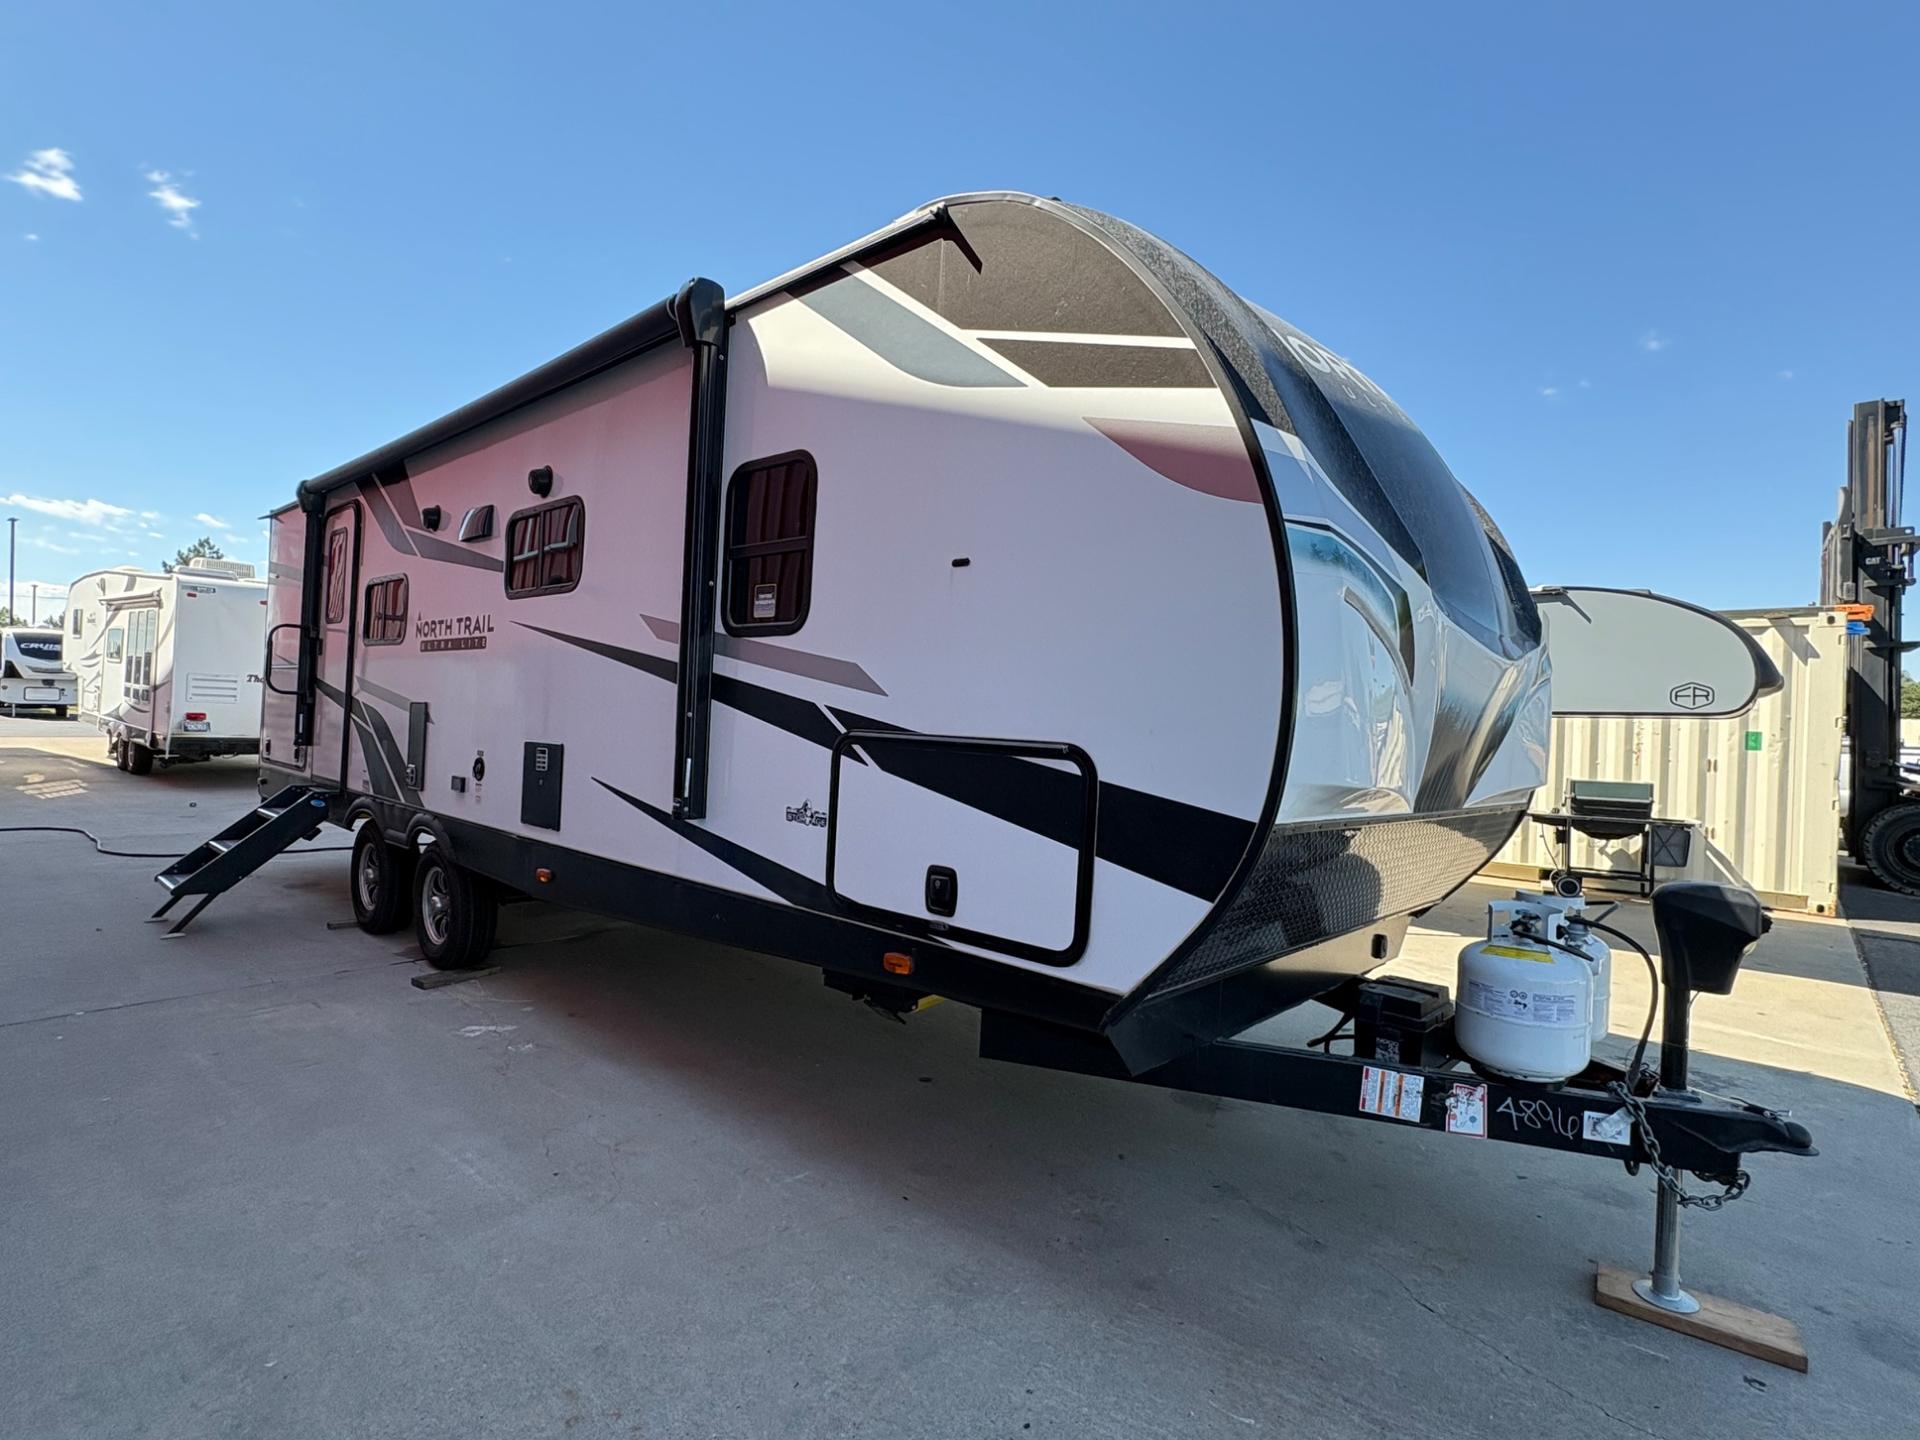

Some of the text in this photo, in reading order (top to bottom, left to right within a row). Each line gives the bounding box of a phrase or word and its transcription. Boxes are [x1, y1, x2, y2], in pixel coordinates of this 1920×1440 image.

[1865, 556, 1881, 565] CAT
[416, 614, 494, 639] NORTH TRAIL
[421, 637, 486, 651] ULTRA LITE
[1496, 1096, 1580, 1140] 4896
